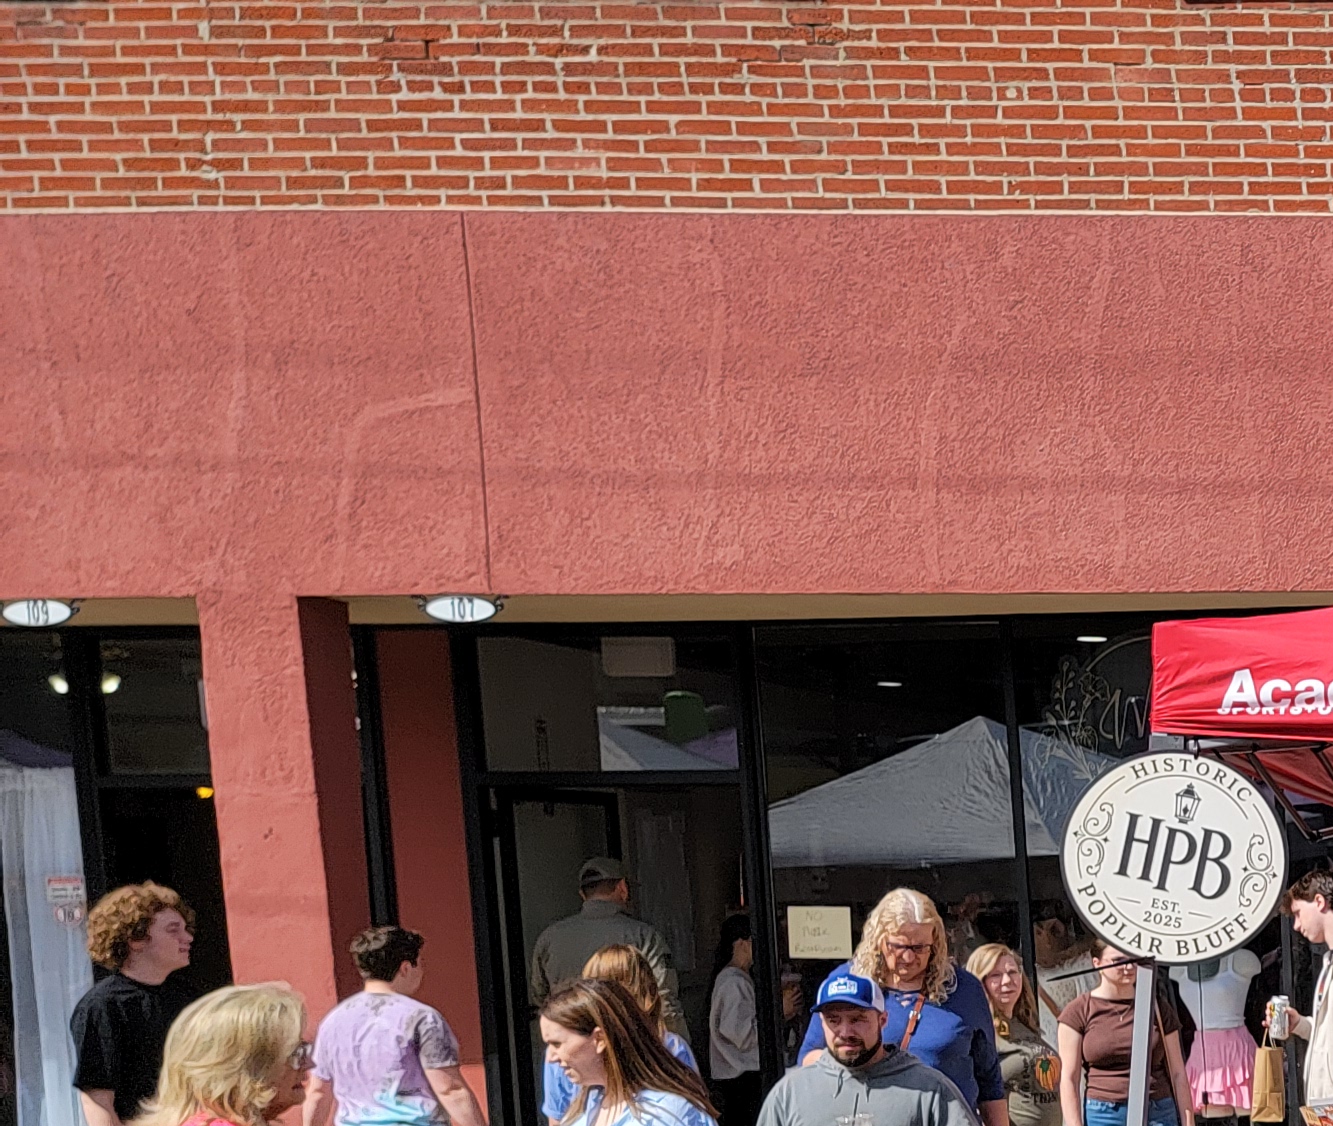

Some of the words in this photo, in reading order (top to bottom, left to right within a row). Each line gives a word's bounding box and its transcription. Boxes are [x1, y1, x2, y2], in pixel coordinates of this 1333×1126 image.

[26, 599, 50, 625] 109
[450, 596, 474, 620] 107
[1129, 757, 1253, 802] HISTORIC
[1113, 811, 1232, 900] HPB
[1150, 897, 1181, 914] EST.
[1077, 882, 1164, 955] POPLAR
[1175, 912, 1250, 956] BLUFF
[1142, 910, 1183, 929] 2025
